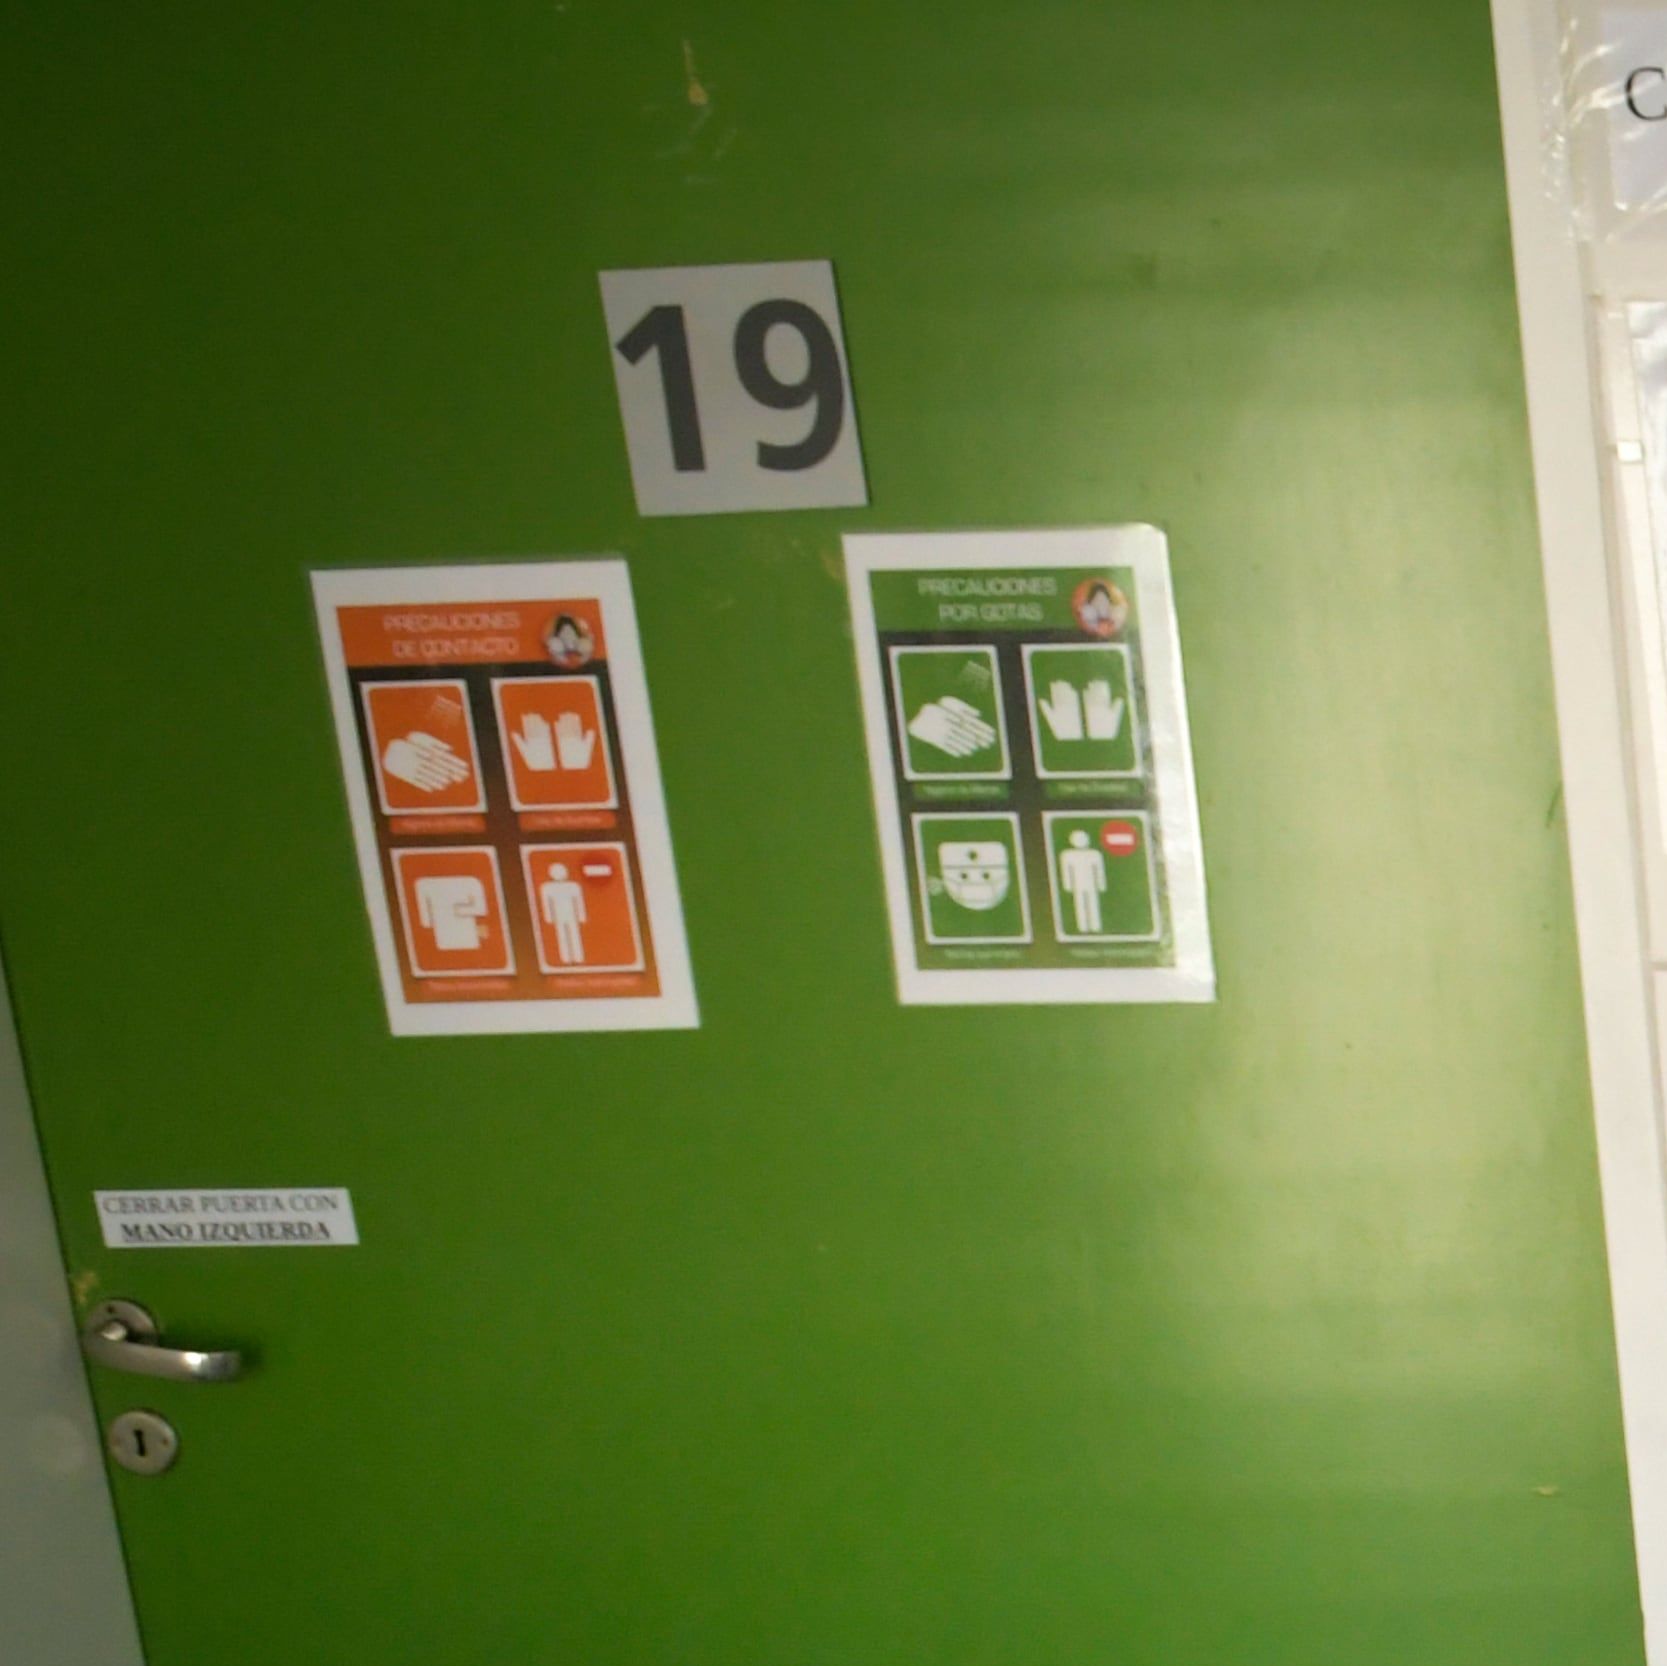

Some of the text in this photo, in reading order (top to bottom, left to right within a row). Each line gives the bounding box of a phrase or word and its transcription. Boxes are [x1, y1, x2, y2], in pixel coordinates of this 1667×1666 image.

[614, 298, 846, 473] 19
[103, 1193, 340, 1215] CERRAR PUERTA CON
[120, 1220, 332, 1242] MANO IZQUIERDA
